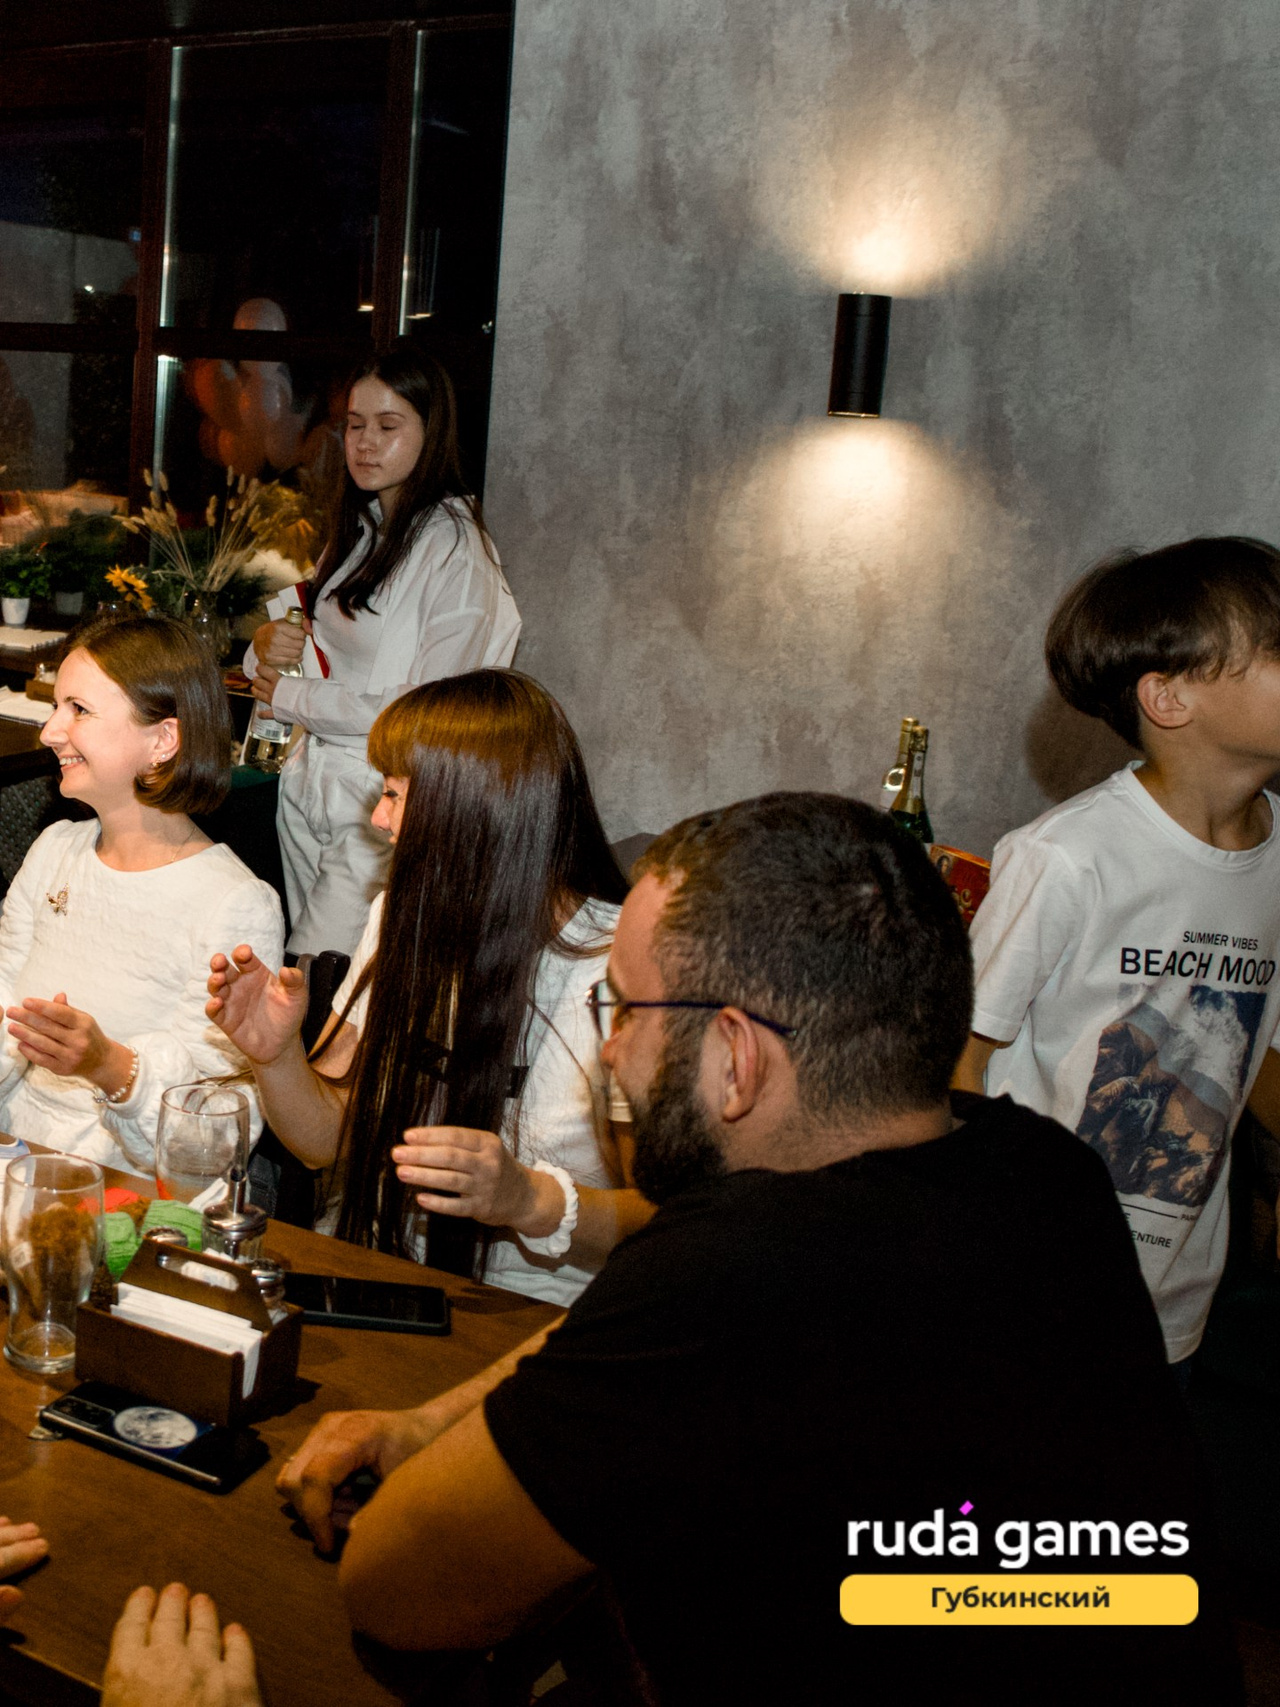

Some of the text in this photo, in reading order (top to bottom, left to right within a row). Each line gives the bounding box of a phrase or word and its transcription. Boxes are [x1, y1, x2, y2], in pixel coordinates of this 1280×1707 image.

[1183, 931, 1258, 950] SUMMER VIBES
[1120, 947, 1277, 986] BEACH MOOD
[1131, 1230, 1172, 1248] ENTURE
